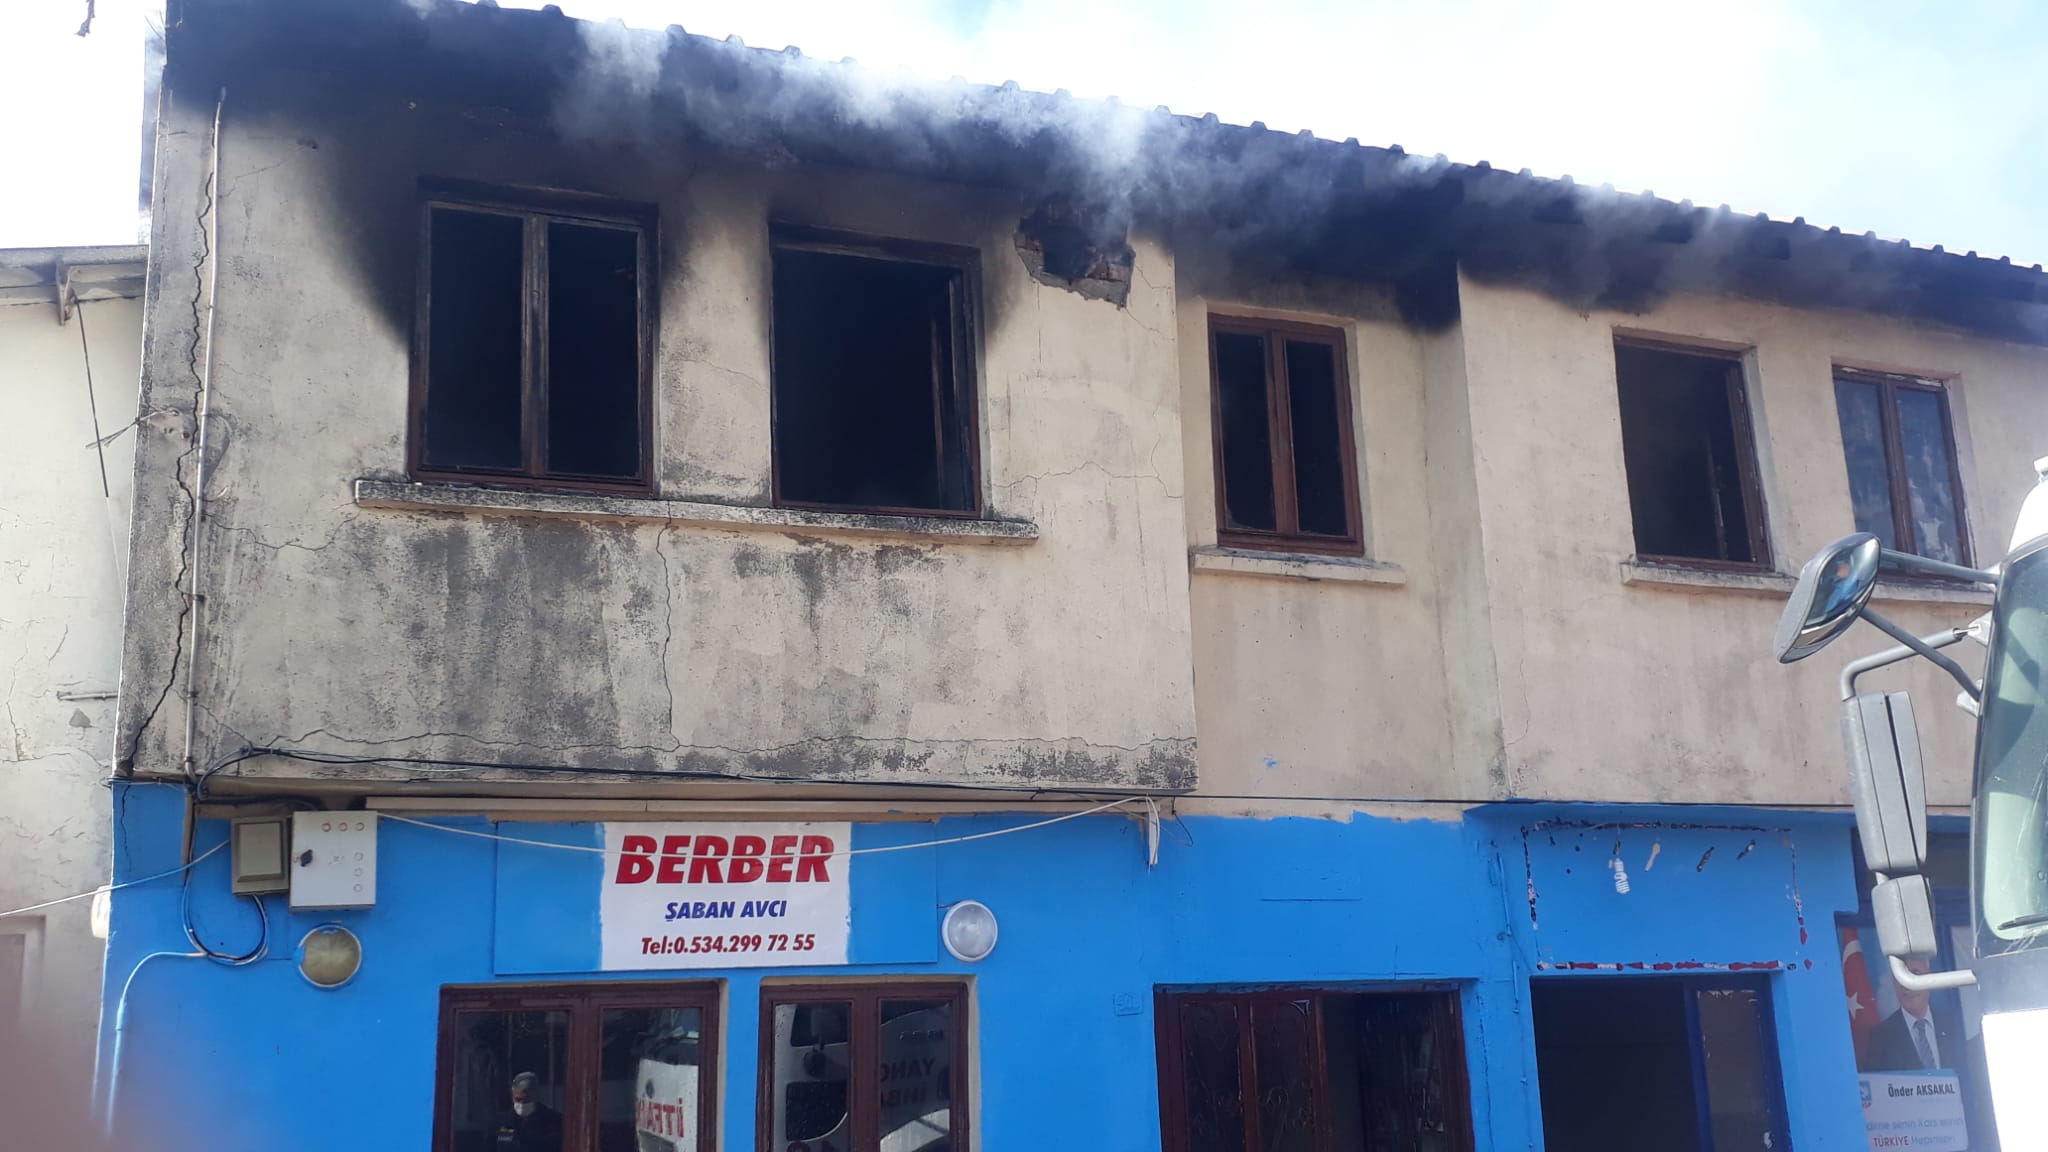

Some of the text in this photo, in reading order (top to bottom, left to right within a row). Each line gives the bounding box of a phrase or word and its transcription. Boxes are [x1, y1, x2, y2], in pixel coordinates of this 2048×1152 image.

[615, 835, 834, 884] BERBER
[665, 900, 787, 922] ŞABAN AVCI
[641, 933, 815, 955] Tel:0.534.299 72 55
[1888, 1083, 1955, 1098] Önder AKSAKAL
[1873, 1134, 1910, 1148] TÜRKİYE
